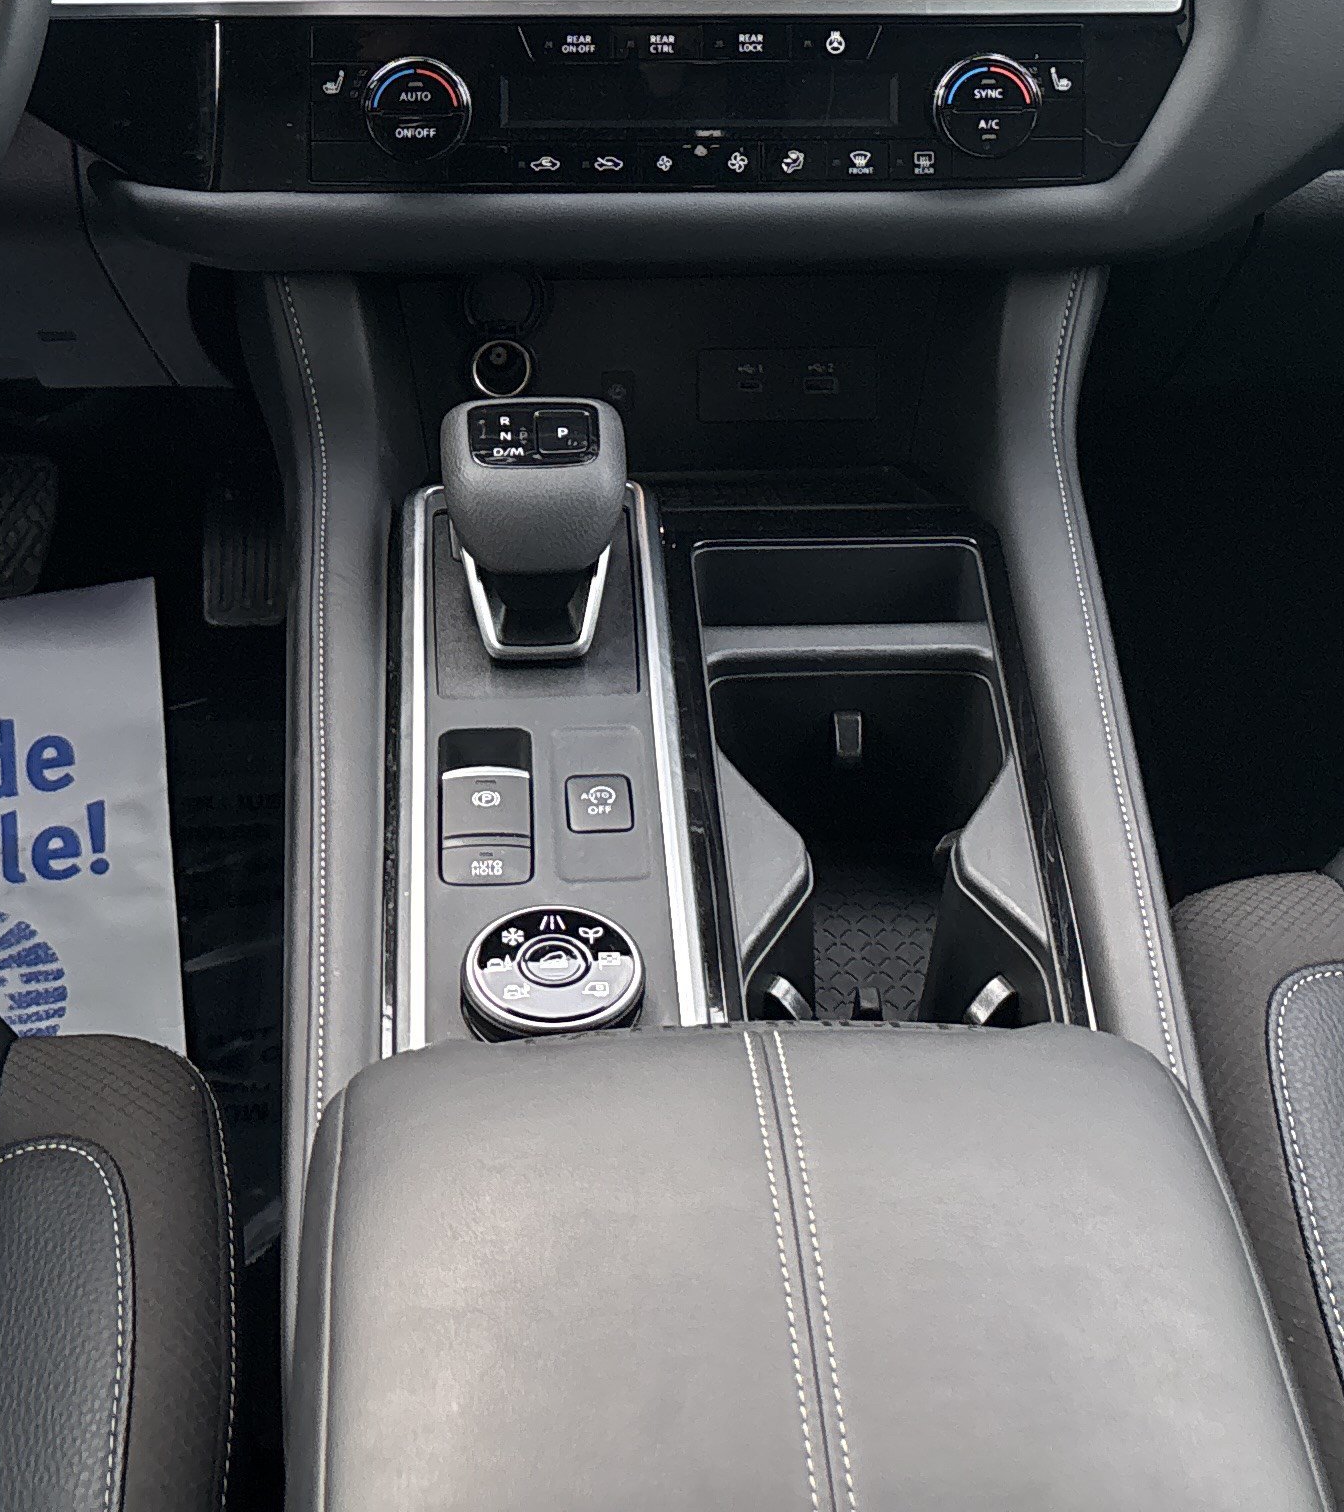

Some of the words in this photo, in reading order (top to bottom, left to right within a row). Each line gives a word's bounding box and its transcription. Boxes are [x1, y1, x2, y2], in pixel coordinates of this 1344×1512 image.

[566, 34, 592, 44] REAR
[649, 34, 675, 44] REAR
[738, 33, 764, 43] REAR
[649, 44, 675, 54] CTRL
[738, 43, 763, 53] LOCK
[399, 91, 432, 102] AUTO
[973, 88, 1004, 99] SYNC
[977, 119, 1001, 130] A/C
[848, 166, 874, 175] FRONT
[499, 416, 511, 426] R
[499, 431, 512, 441] N
[557, 427, 569, 439] P
[492, 447, 525, 457] D/M
[580, 791, 611, 800] AUTO
[587, 805, 613, 816] OFF
[471, 859, 504, 868] AUTO
[471, 867, 504, 877] HOLD
